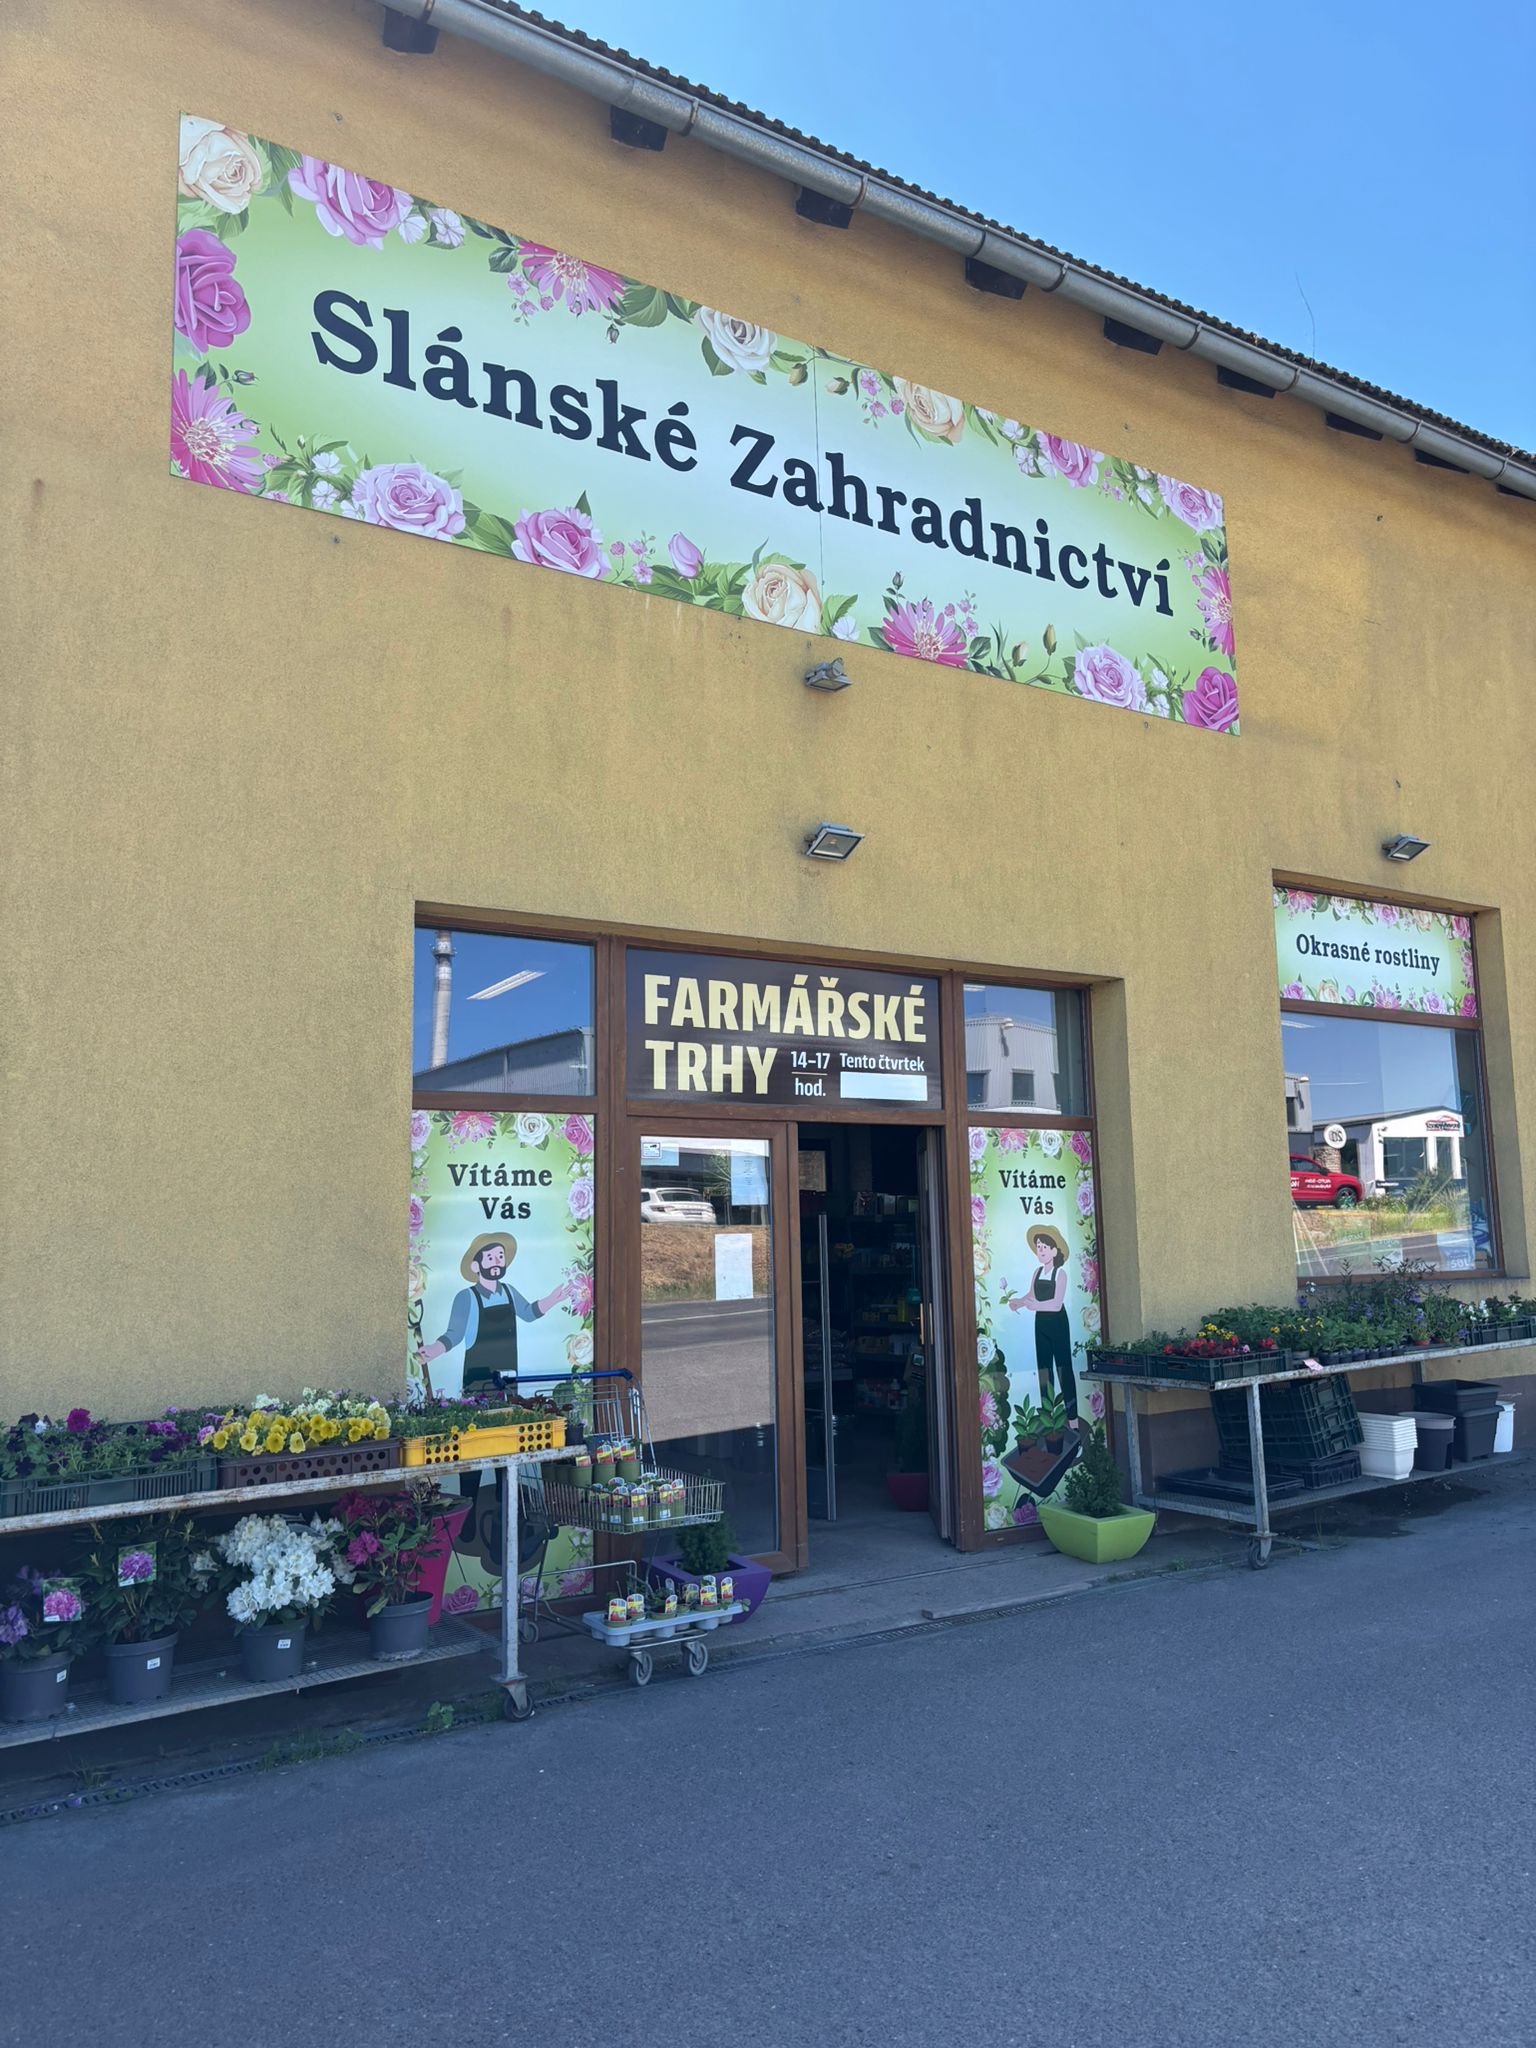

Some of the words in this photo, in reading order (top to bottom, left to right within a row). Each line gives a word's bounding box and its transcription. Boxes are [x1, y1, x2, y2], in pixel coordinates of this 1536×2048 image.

[311, 289, 698, 473] Slánské
[729, 424, 1174, 617] Zahradnictví
[1296, 933, 1370, 962] Okrasné
[1375, 947, 1440, 976] rostliny
[644, 973, 927, 1043] FARMÁŘSKÉ
[644, 1039, 778, 1095] TRHY
[839, 1052, 876, 1070] Tento
[878, 1054, 925, 1072] čtvrtek
[795, 1077, 826, 1097] hod.
[447, 1162, 553, 1187] Vítáme
[998, 1169, 1066, 1189] Vítáme
[478, 1195, 531, 1219] Vás
[1020, 1196, 1054, 1215] Vás
